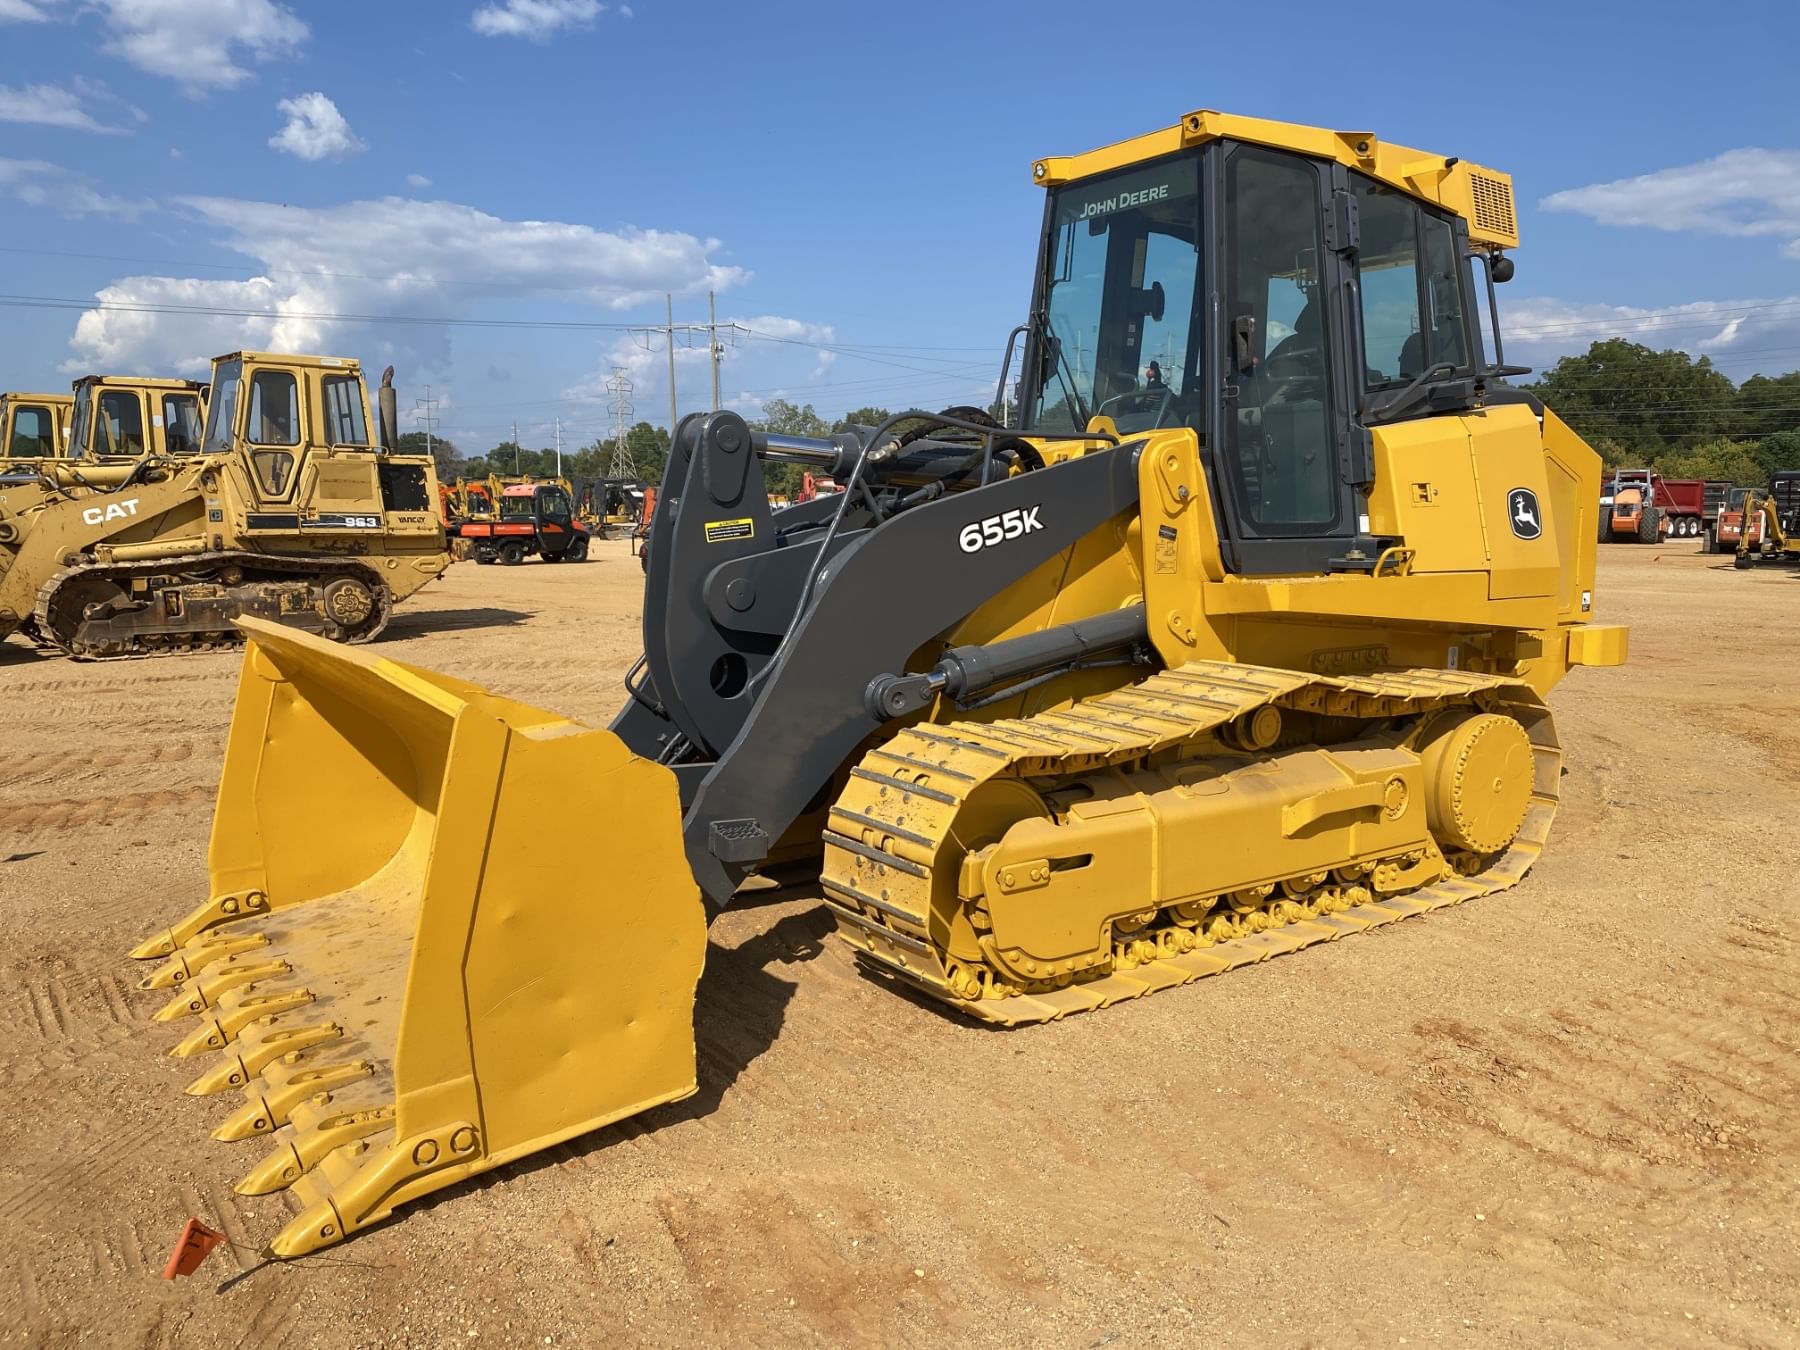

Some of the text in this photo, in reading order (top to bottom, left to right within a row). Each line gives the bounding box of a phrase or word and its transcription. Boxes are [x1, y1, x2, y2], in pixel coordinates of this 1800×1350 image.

[1079, 184, 1169, 218] JOHN DEERE
[82, 498, 139, 525] CAT
[958, 504, 1046, 553] 655K
